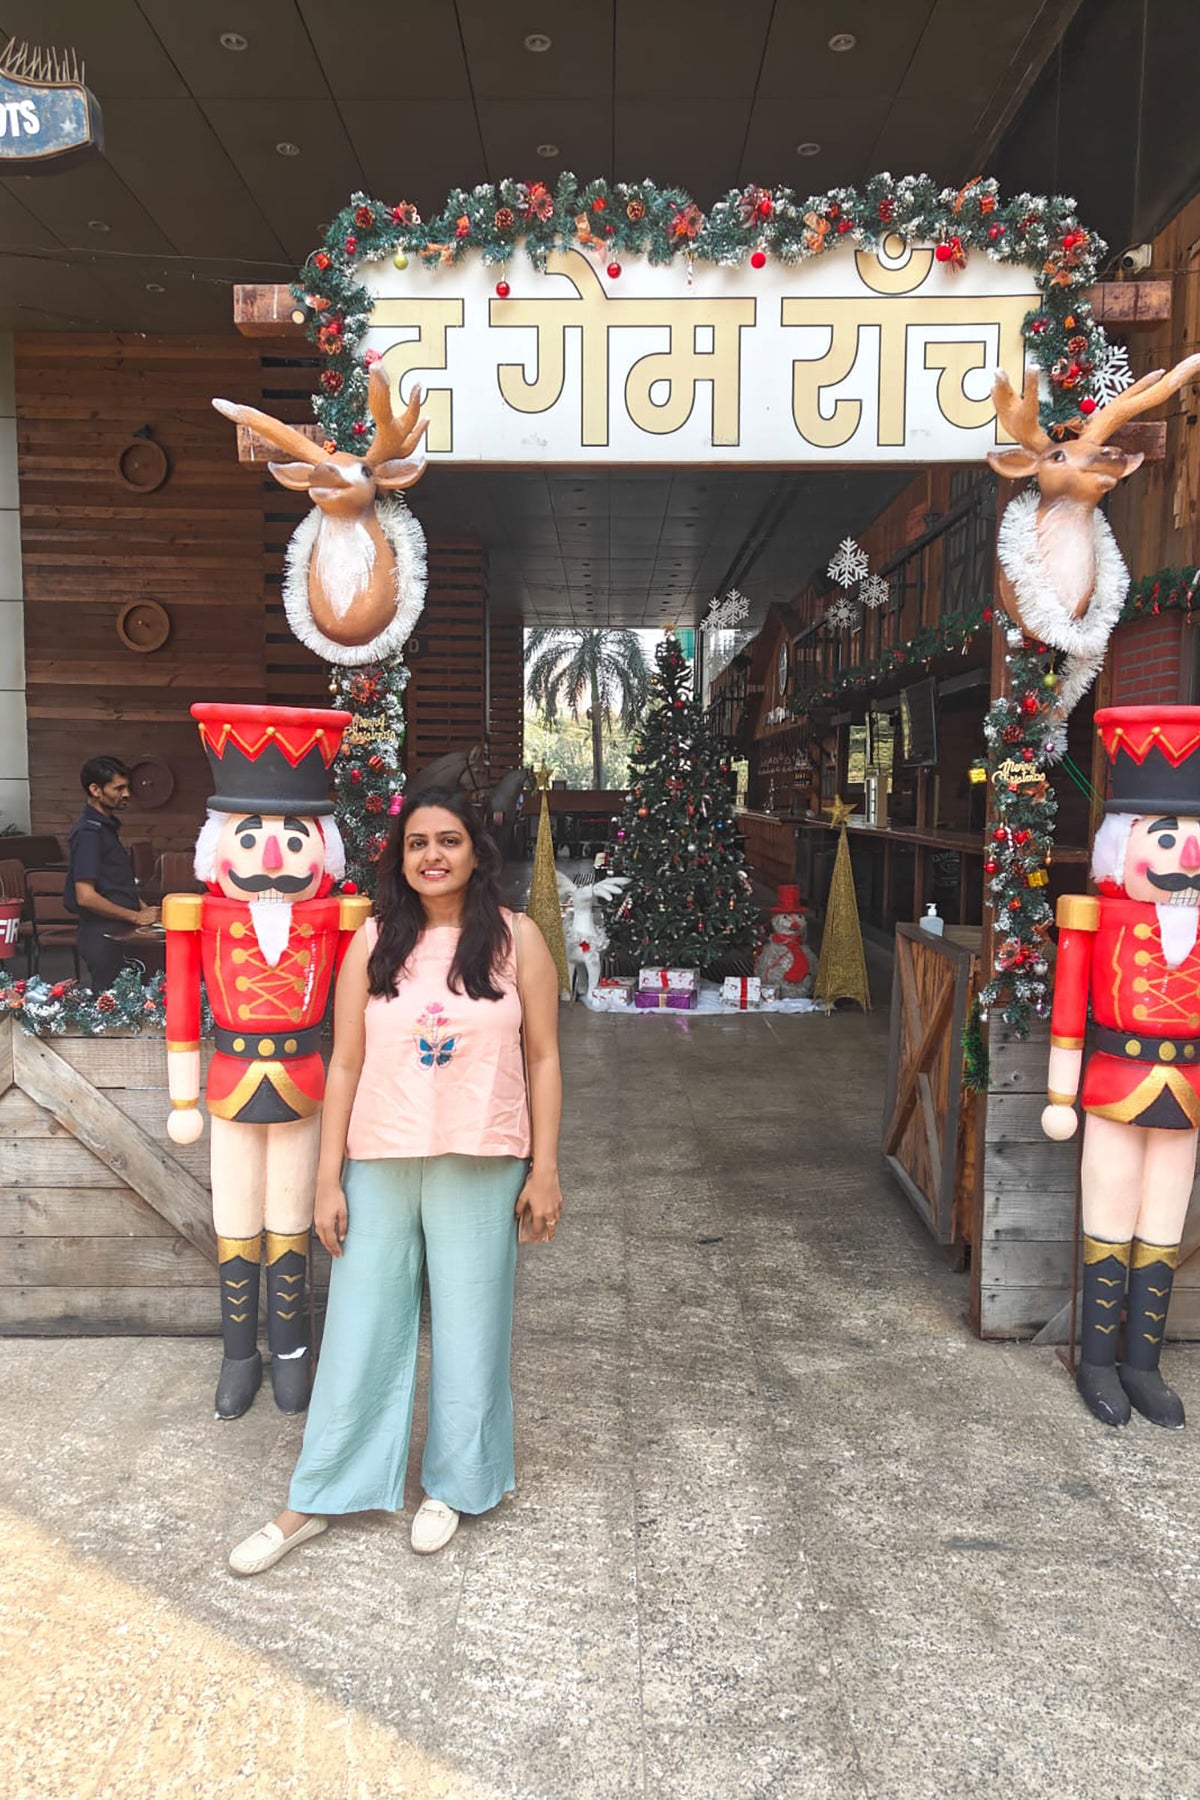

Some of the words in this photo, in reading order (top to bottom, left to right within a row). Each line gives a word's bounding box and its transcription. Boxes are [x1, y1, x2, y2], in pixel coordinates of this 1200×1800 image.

[367, 297, 465, 453] द
[488, 245, 757, 448] गेम
[998, 758, 1036, 774] Merry
